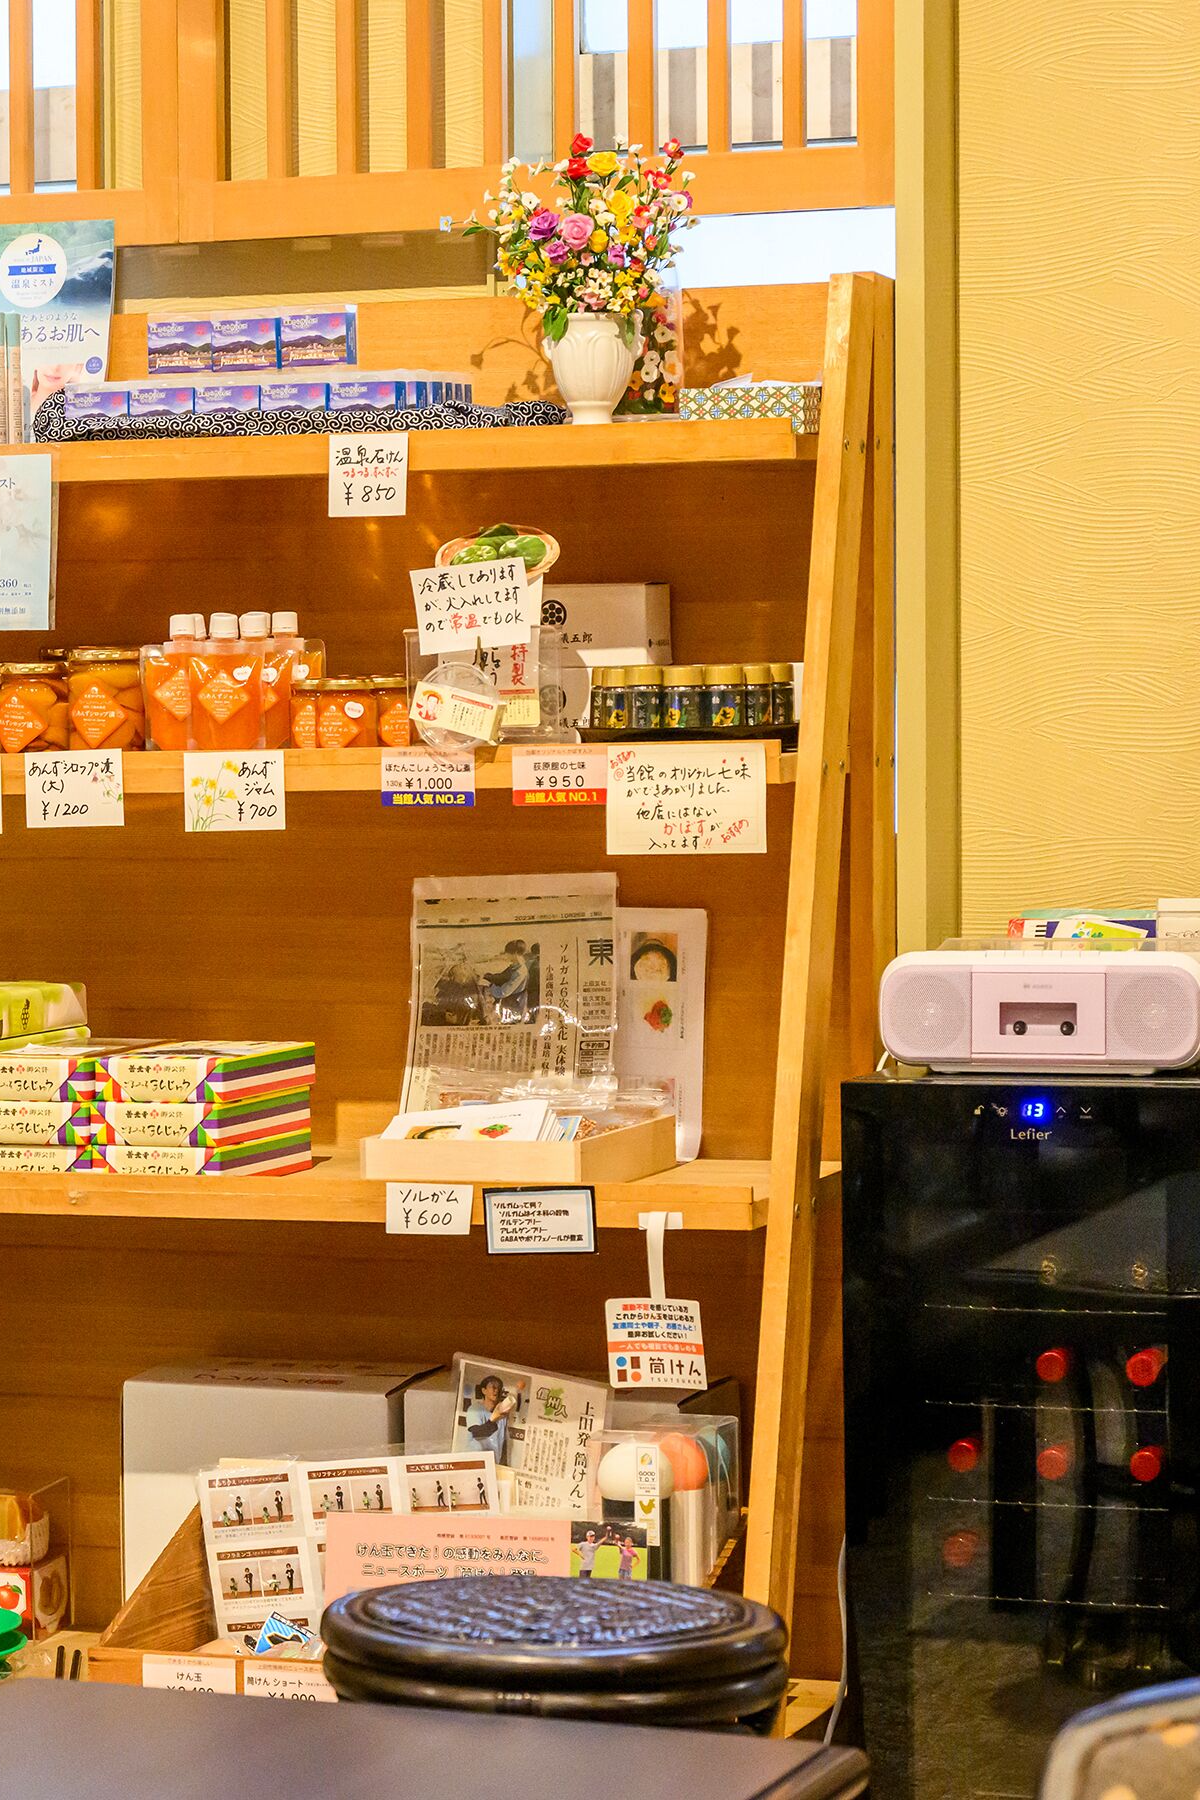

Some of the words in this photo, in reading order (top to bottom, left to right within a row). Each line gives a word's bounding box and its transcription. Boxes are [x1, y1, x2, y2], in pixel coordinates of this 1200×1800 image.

[11, 277, 55, 289] 温泉ミスト
[21, 324, 100, 344] あるお肌へ
[336, 445, 403, 466] 温泉石けん
[418, 564, 516, 595] 冷蔵してあります
[425, 608, 524, 634] ので常温でもOK
[510, 643, 528, 686] 特製
[28, 759, 115, 776] あんずシロップ漬
[238, 760, 277, 777] あんず
[626, 763, 751, 782] 当館のオリジナル七味
[244, 780, 275, 797] ジャム
[392, 794, 434, 805] 当館人気
[435, 794, 466, 804] NO.2
[525, 793, 566, 804] 当館人気
[573, 791, 598, 802] NO.1
[41, 801, 89, 819] ¥1200
[237, 801, 278, 823] ¥700
[636, 803, 717, 820] 他店にはない
[587, 938, 613, 966] 東
[1026, 1102, 1045, 1118] 13
[1010, 1128, 1050, 1140] Lefier
[400, 1188, 459, 1204] ソルガム
[403, 1208, 453, 1229] ¥600
[615, 1313, 695, 1322] これからけん玉をはじめる方
[649, 1356, 701, 1376] 筒けん
[176, 1672, 202, 1683] けん玉
[273, 1678, 304, 1688] ショート
